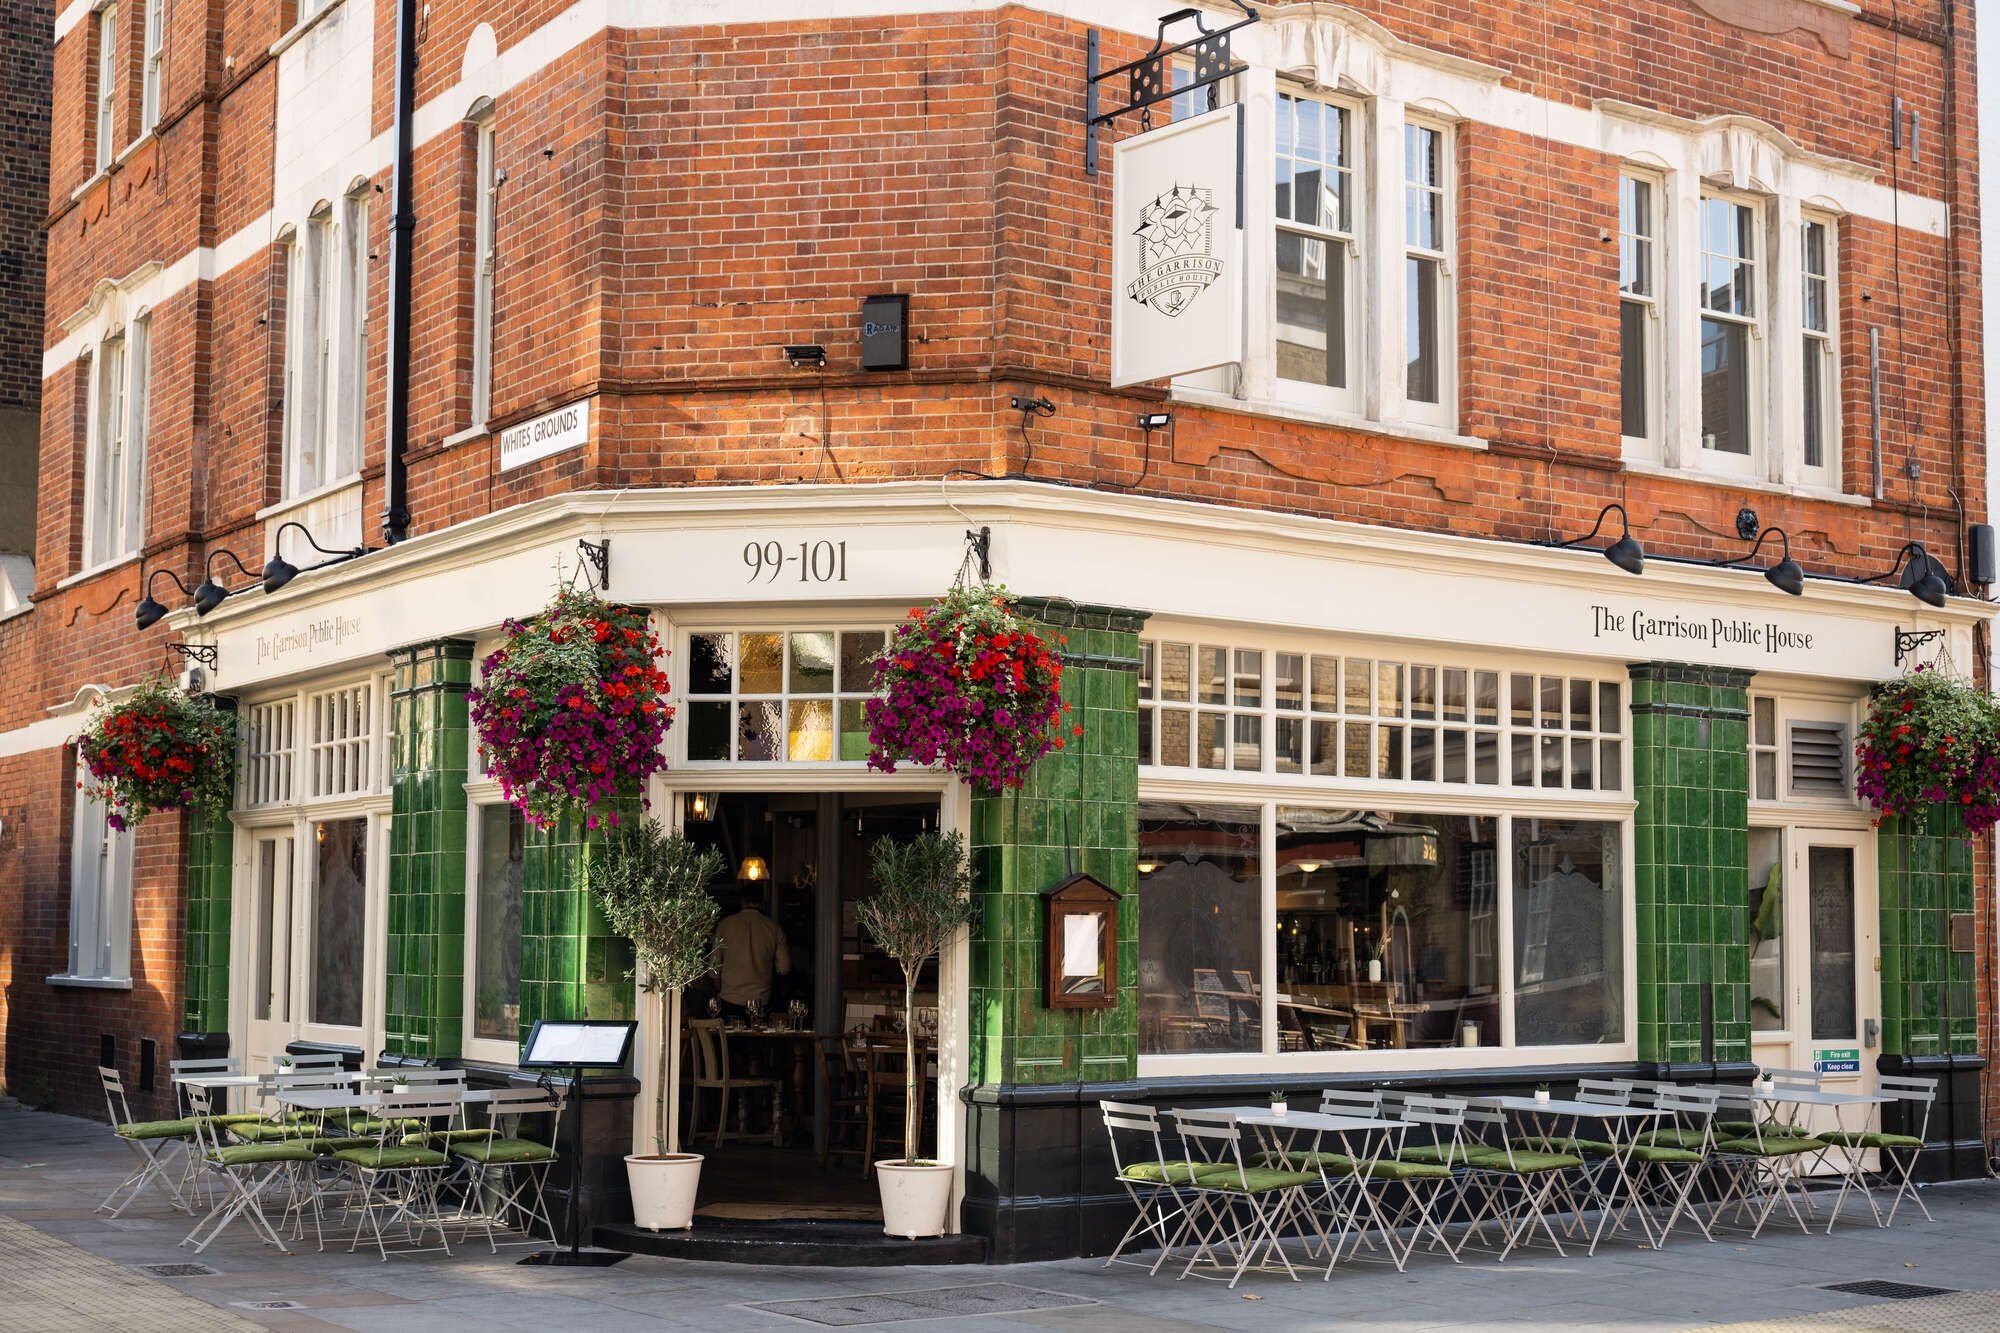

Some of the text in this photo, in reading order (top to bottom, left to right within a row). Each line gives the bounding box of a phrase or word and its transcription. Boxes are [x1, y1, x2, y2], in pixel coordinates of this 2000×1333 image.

[1131, 259, 1220, 293] THE GARRISON
[1141, 274, 1209, 298] PUBLIC HOUSE
[502, 409, 578, 454] WHITES GROUNDS
[743, 540, 848, 584] 99-101
[256, 616, 361, 664] The Garrison Public House
[1591, 606, 1814, 653] The Garrison Public House
[1827, 1063, 1841, 1071] Keep
